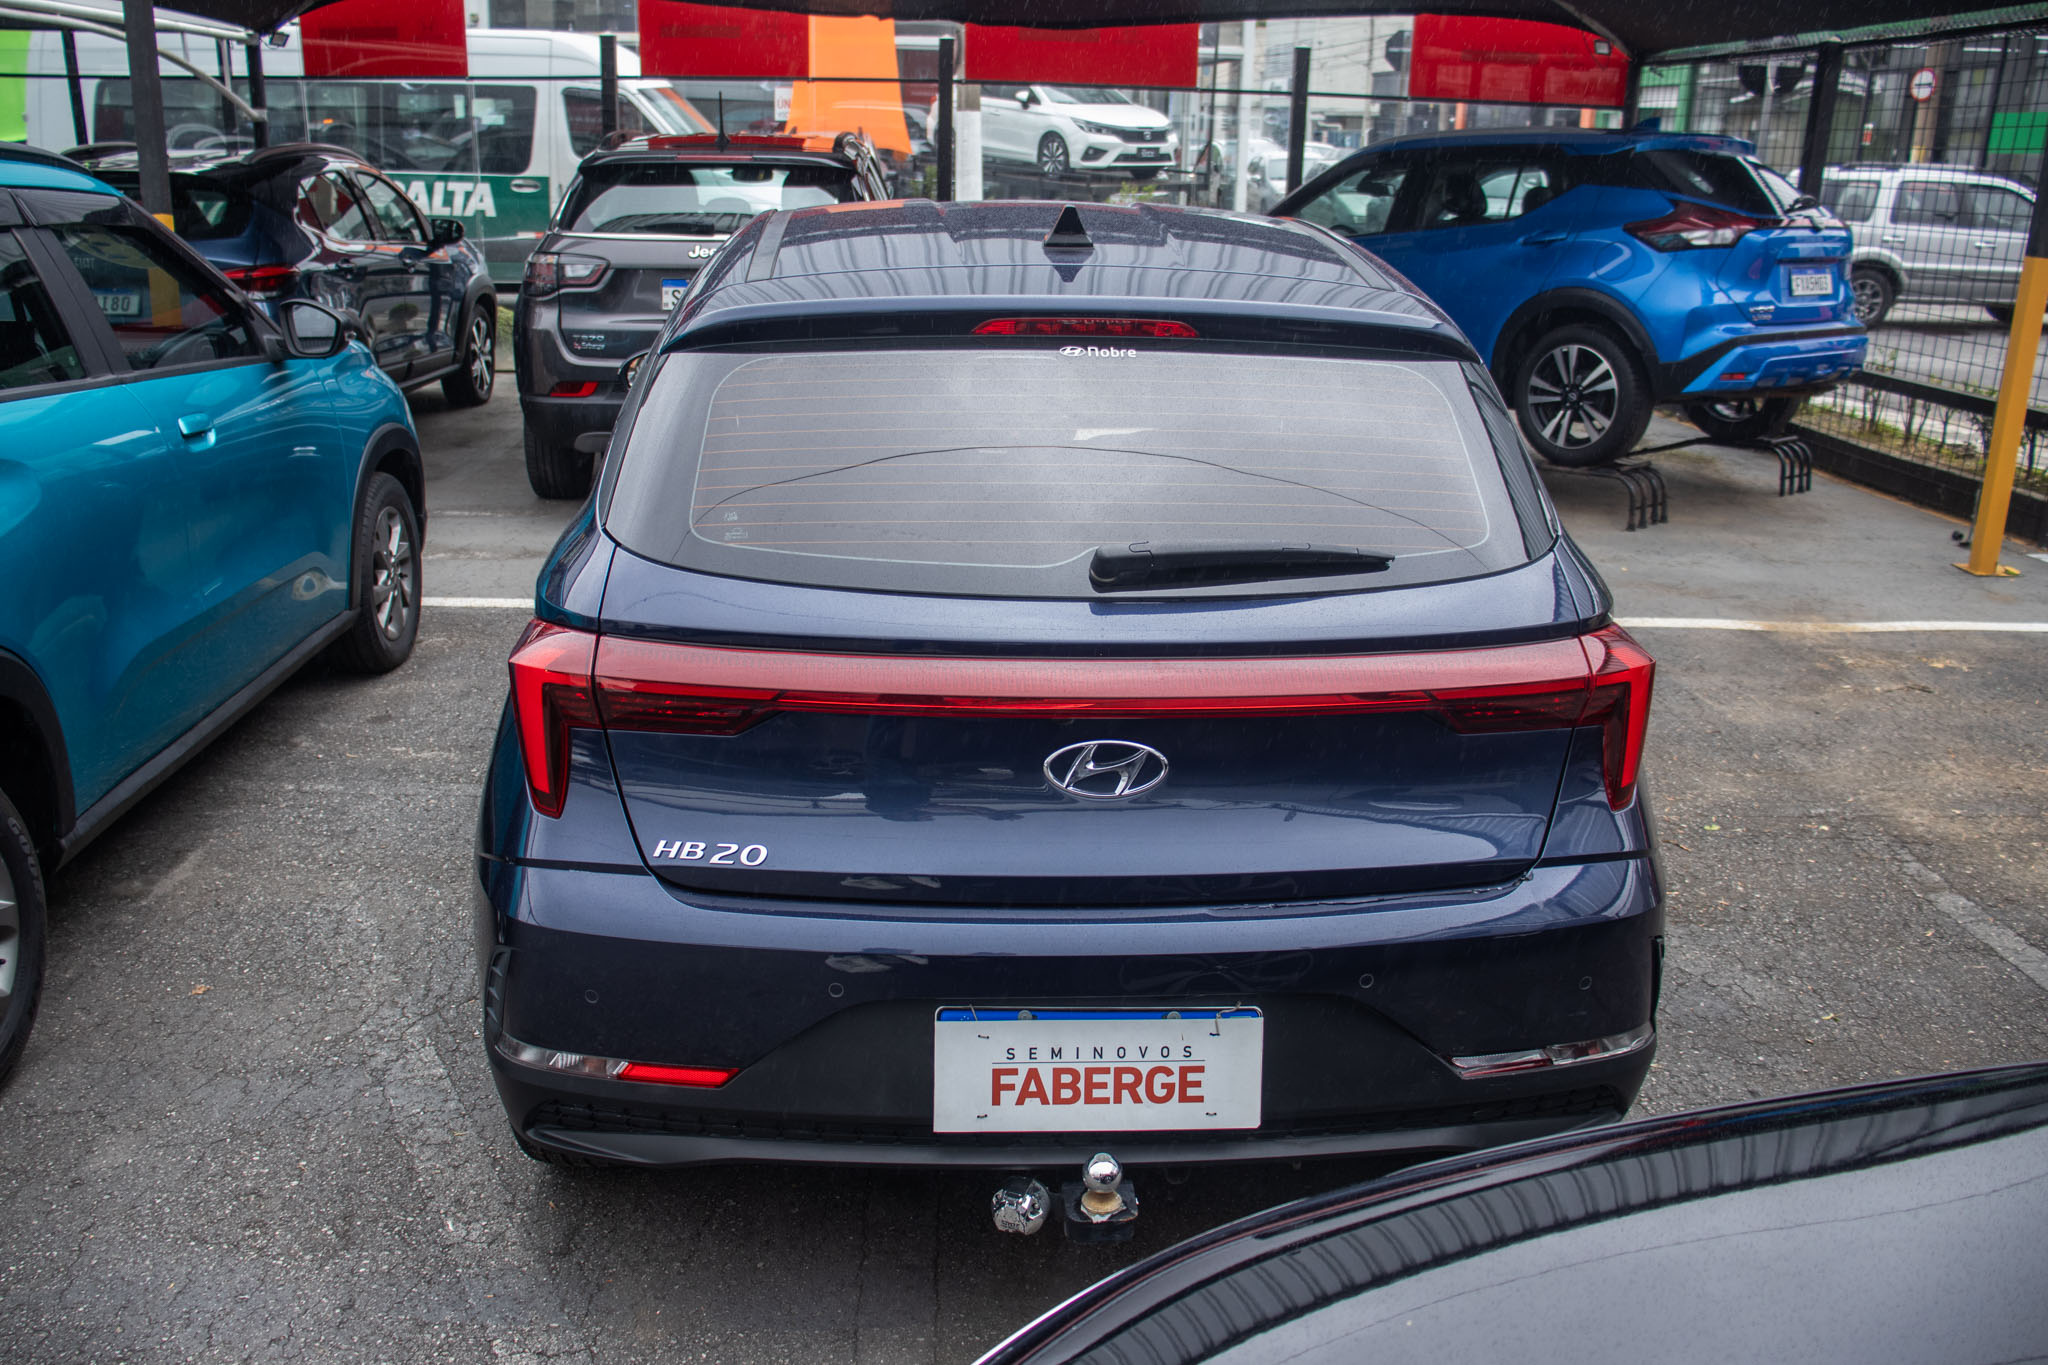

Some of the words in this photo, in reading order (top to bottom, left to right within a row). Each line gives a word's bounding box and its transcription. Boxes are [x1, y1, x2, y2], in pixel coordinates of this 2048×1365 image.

[393, 180, 497, 217] ALTA
[1006, 1045, 1193, 1060] SEMINOVOS
[991, 1065, 1206, 1106] FABERGE
